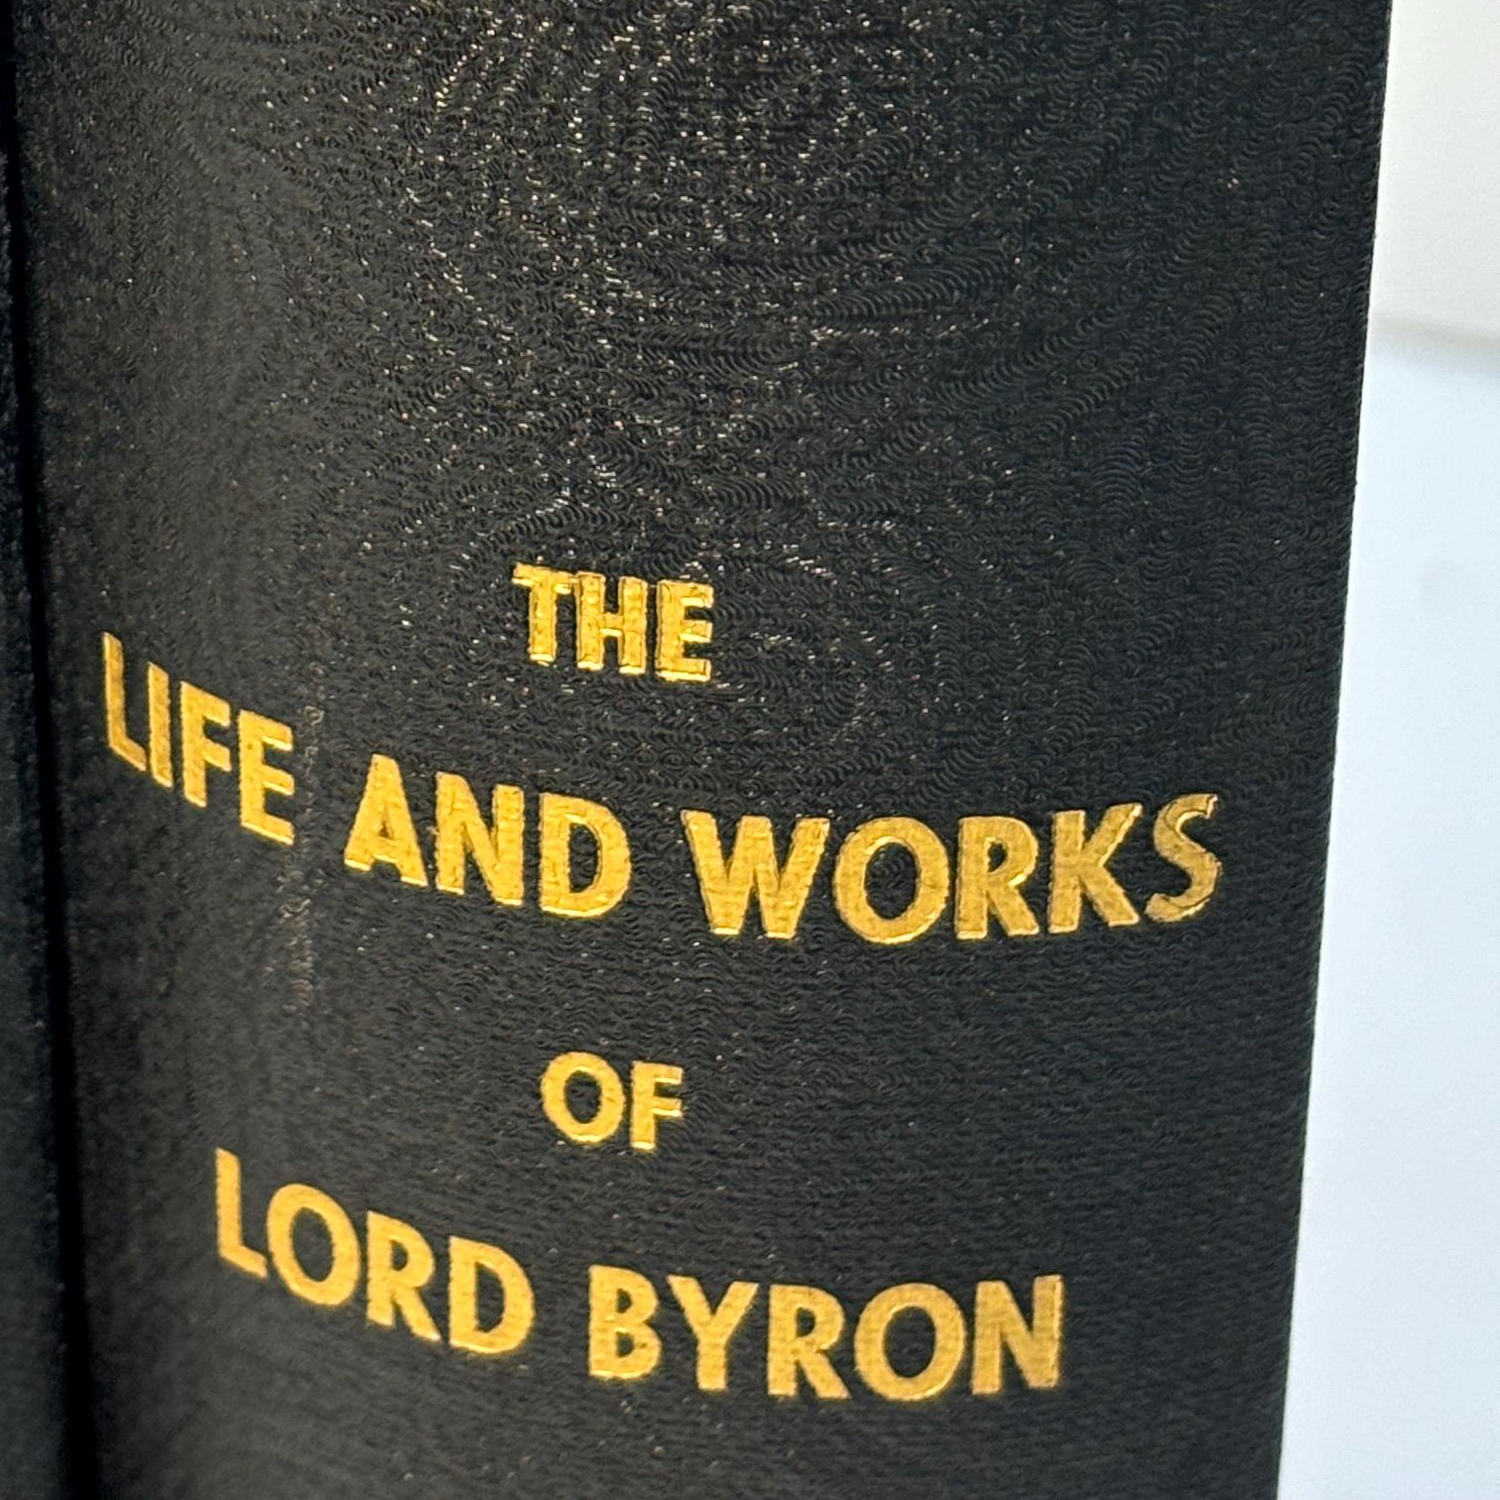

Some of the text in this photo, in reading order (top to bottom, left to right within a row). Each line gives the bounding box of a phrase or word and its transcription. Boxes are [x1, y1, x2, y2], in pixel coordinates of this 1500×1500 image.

[512, 563, 716, 683] THE
[100, 632, 1221, 946] LIFE AND WORKS
[539, 1050, 685, 1153] OF
[214, 1149, 1066, 1403] LORD BYRON
